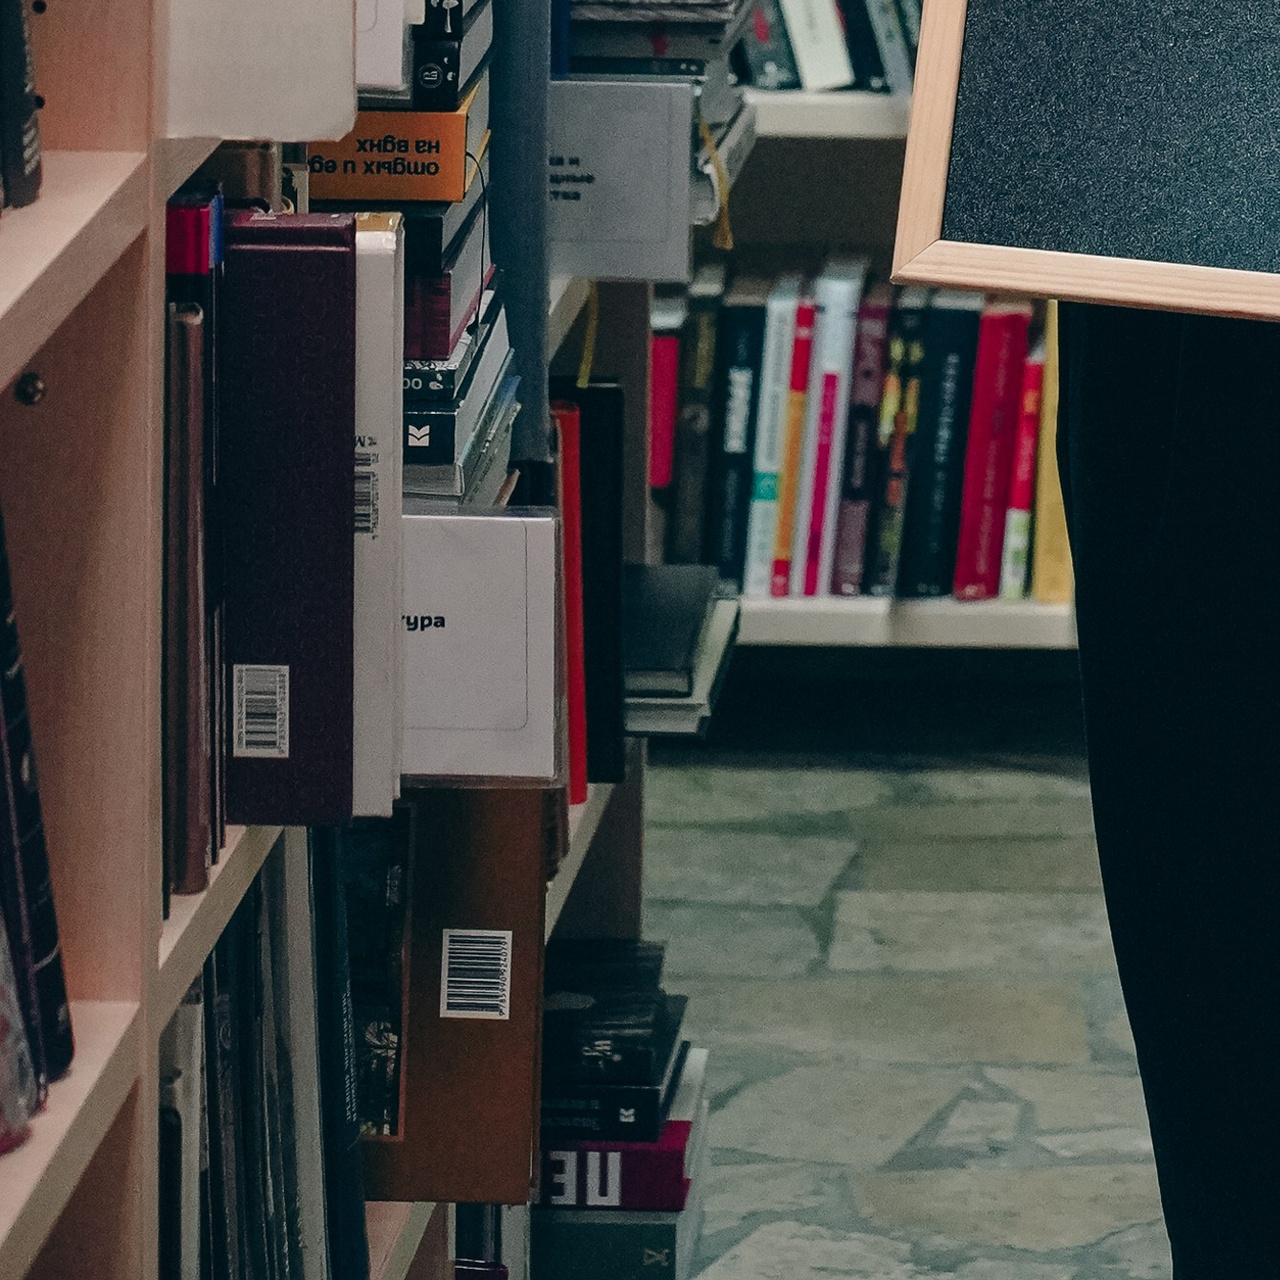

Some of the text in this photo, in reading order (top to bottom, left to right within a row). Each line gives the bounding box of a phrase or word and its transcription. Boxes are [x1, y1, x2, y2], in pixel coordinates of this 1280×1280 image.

[307, 154, 338, 174] ед
[401, 615, 446, 633] ура
[549, 1151, 622, 1207] ПЕ
